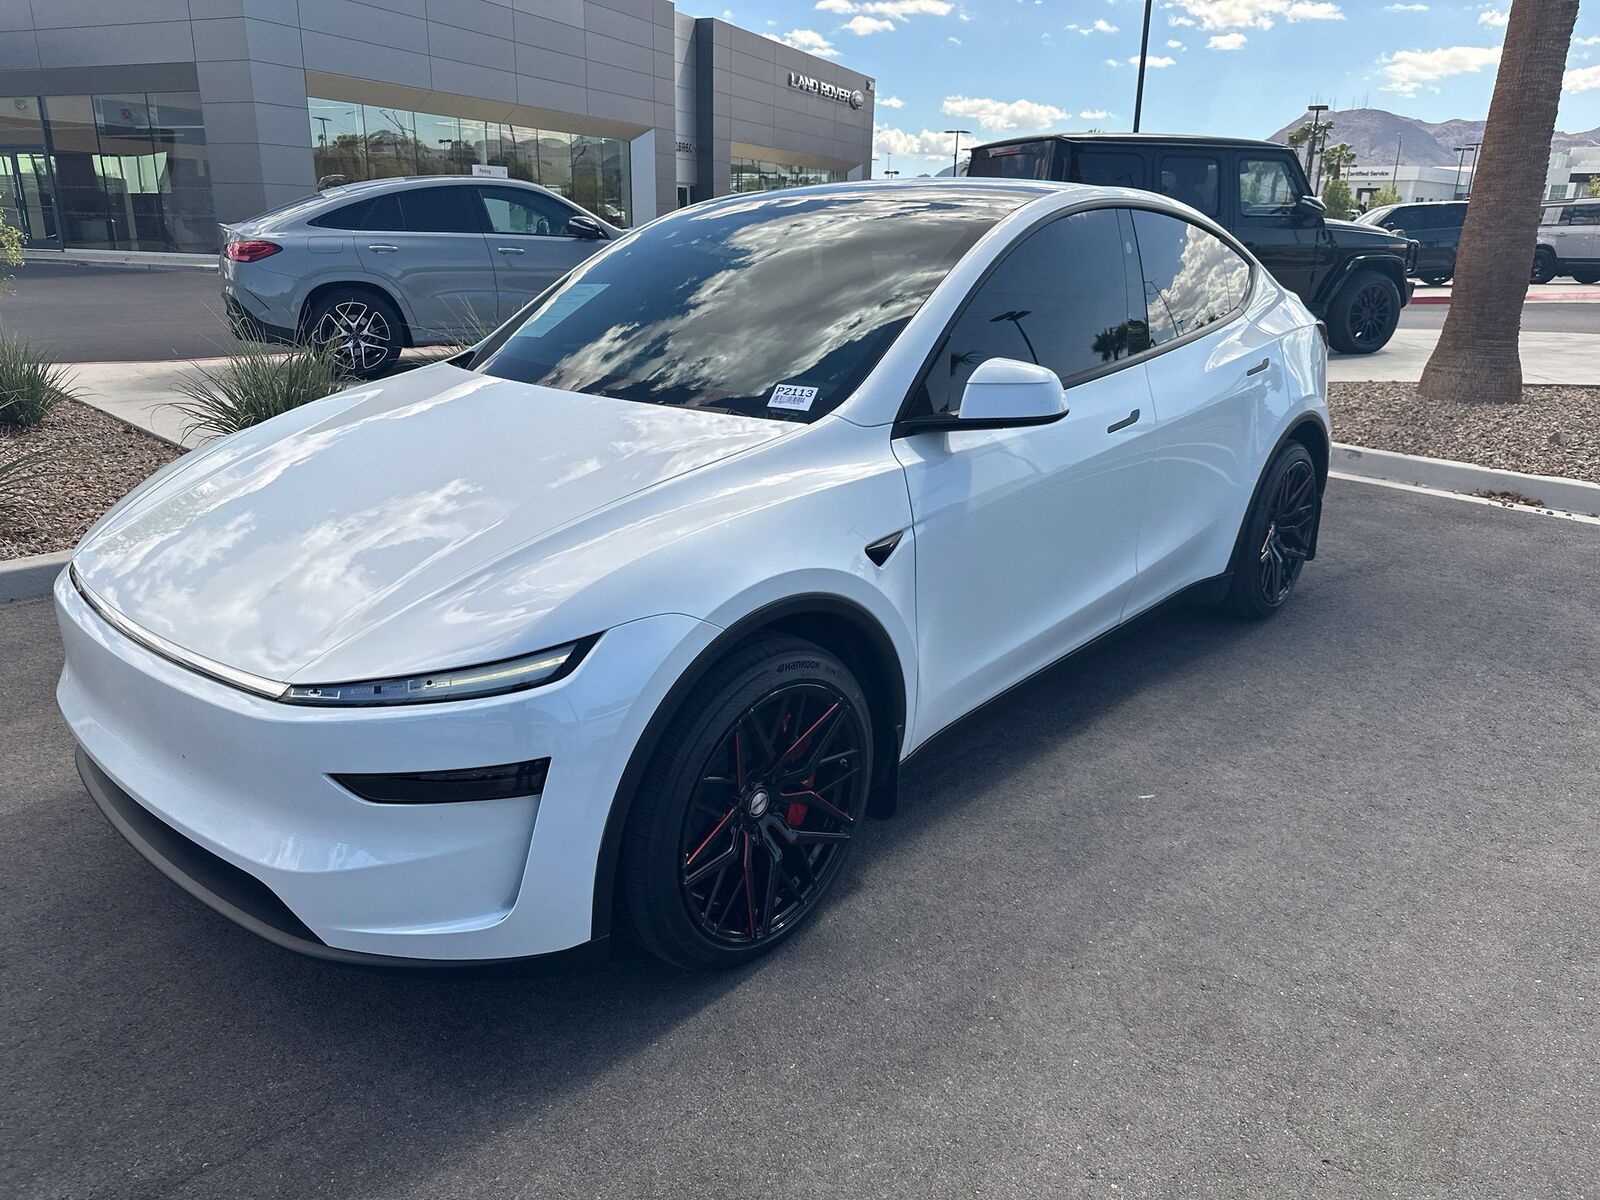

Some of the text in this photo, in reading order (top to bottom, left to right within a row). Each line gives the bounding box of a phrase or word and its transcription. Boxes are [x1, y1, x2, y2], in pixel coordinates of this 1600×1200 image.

[788, 72, 851, 102] LAND ROVER
[775, 386, 814, 398] P2113
